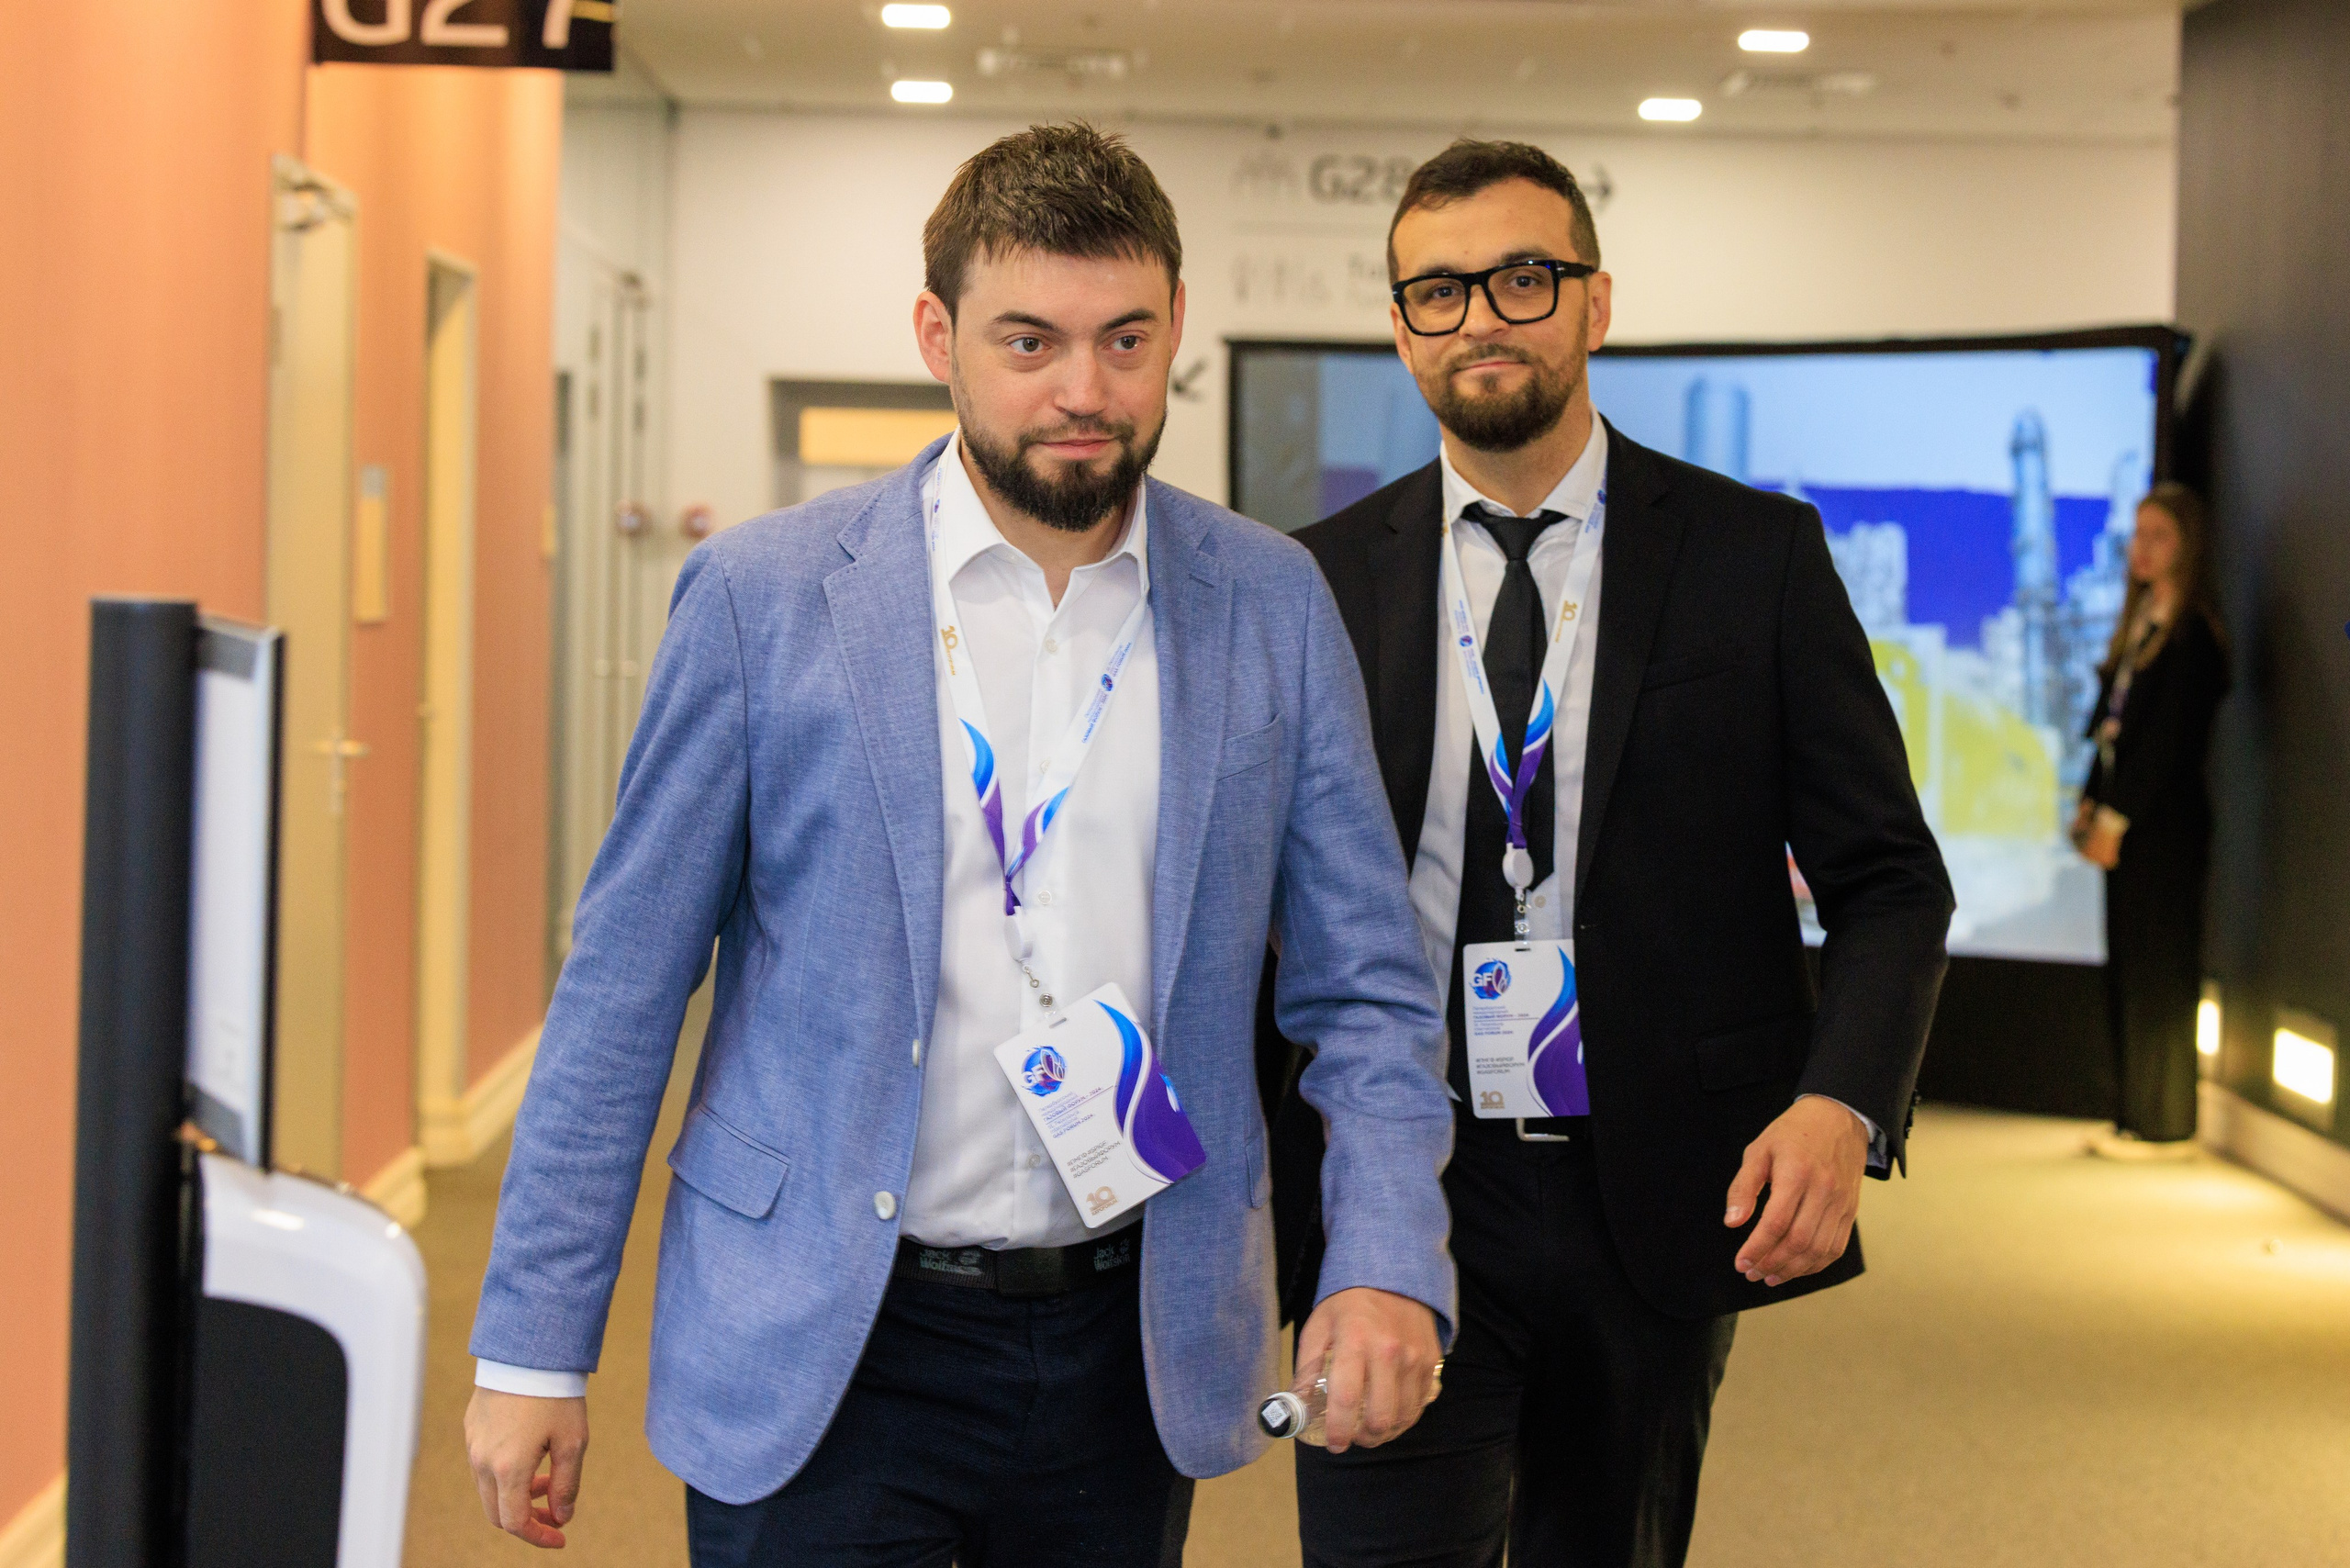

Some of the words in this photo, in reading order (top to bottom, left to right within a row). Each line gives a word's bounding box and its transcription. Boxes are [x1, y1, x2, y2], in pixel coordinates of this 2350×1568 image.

[1043, 1104, 1067, 1122] ГАЗОВЫЙ
[1052, 1130, 1063, 1139] GAS
[1063, 1120, 1080, 1132] FORUM
[1072, 1156, 1109, 1179] #GASFORUM
